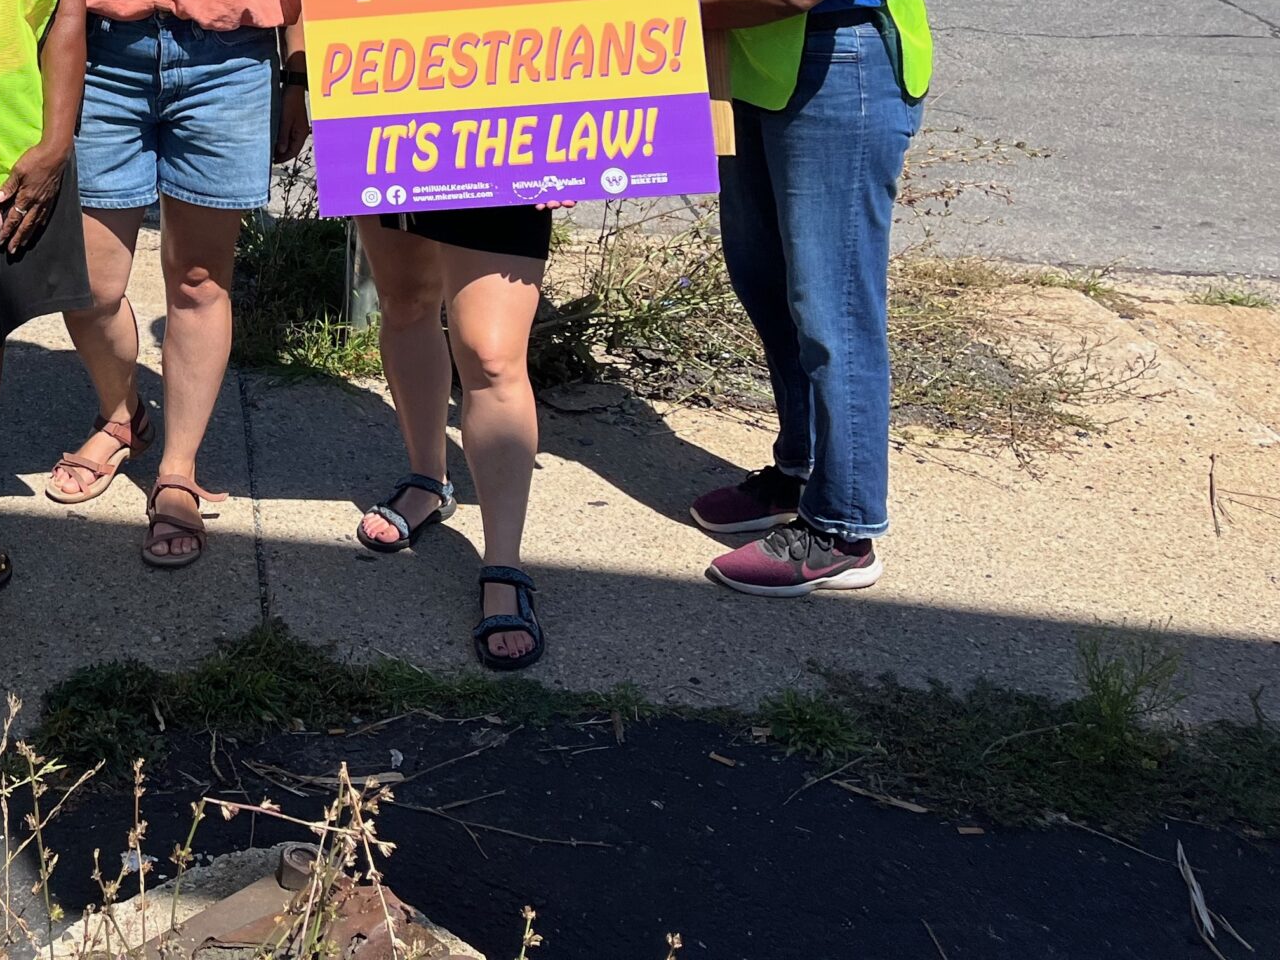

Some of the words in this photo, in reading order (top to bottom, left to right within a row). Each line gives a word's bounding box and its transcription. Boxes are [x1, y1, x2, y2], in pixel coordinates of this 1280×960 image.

[320, 16, 687, 98] PEDESTRIANS!
[366, 119, 441, 175] IT'S
[452, 113, 539, 169] THE
[545, 107, 659, 162] LAW!
[412, 190, 494, 202] www.mkewalks.com
